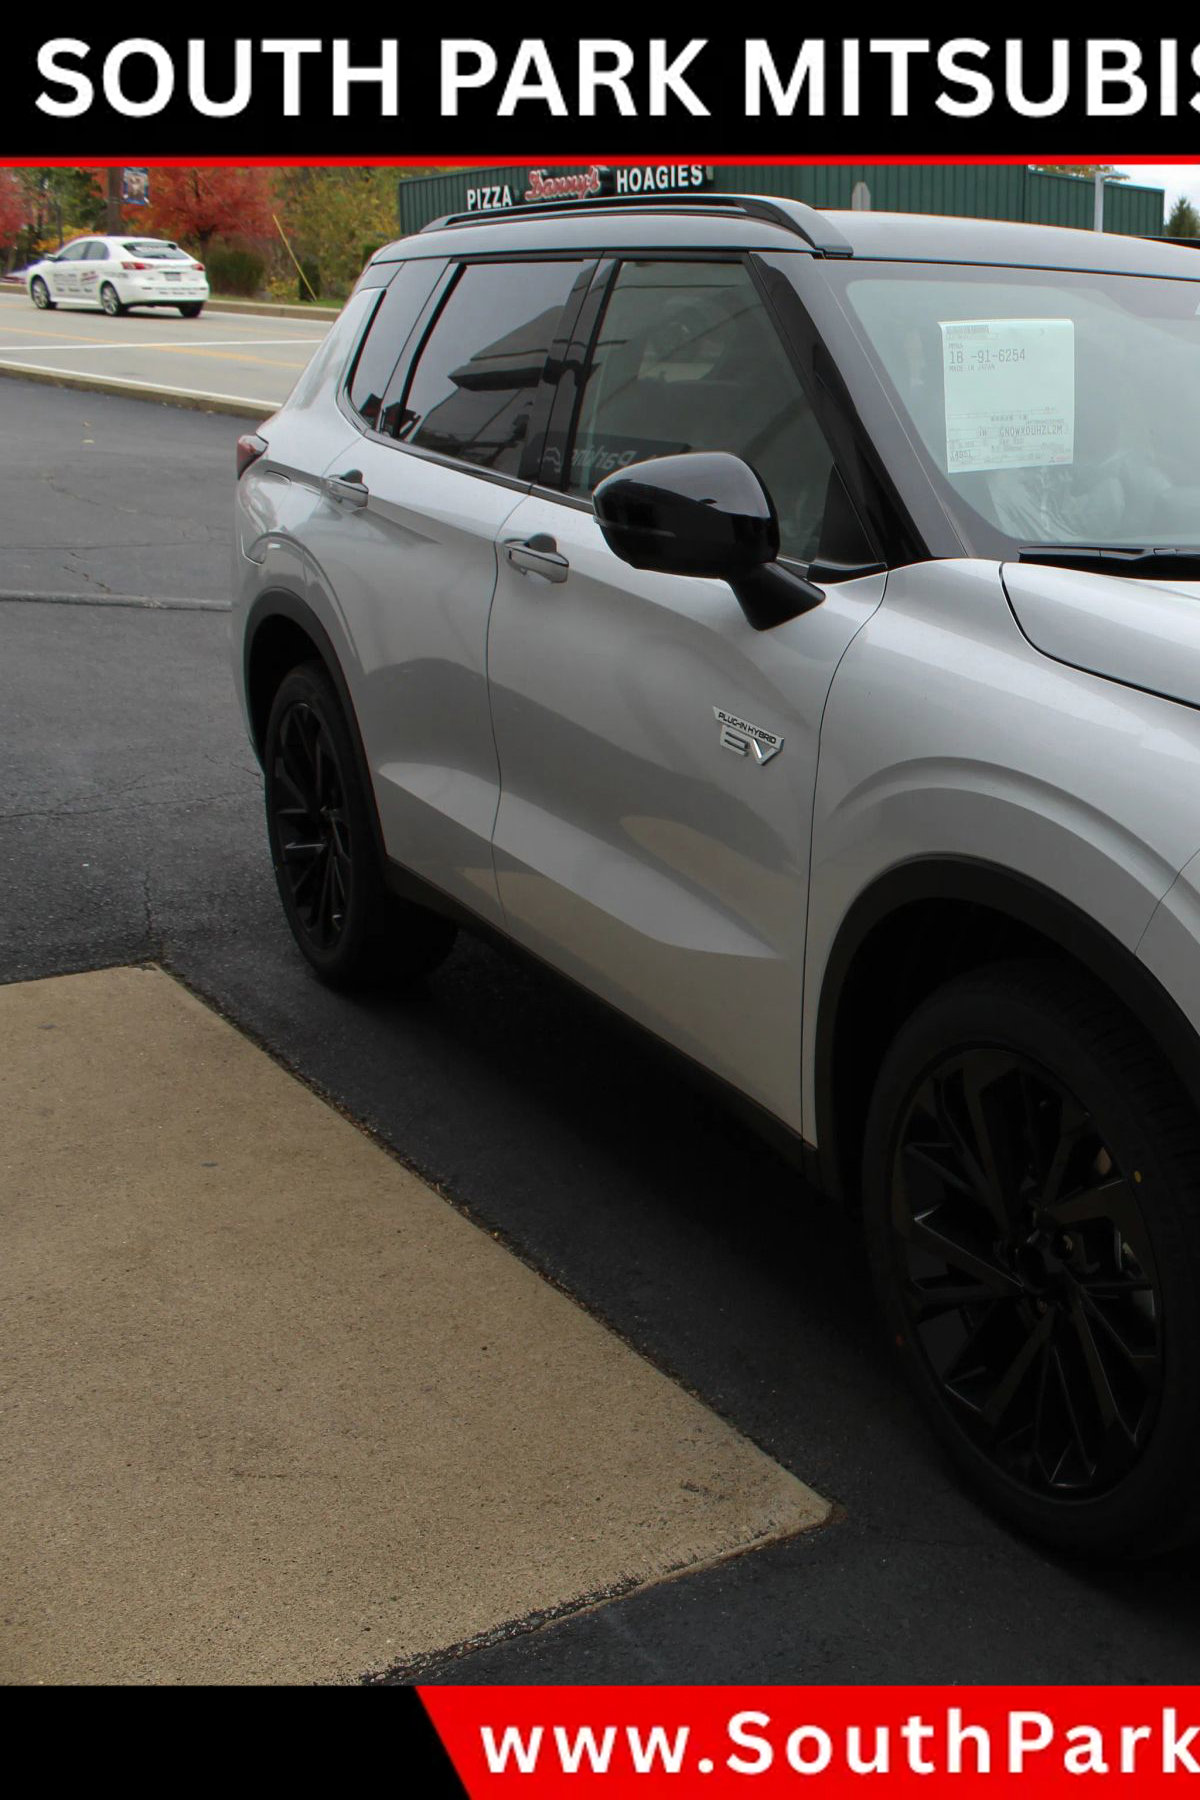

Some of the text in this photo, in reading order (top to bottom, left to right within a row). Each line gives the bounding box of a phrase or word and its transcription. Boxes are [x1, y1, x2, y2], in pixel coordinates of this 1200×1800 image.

[616, 165, 704, 193] HOAGIES
[467, 185, 513, 210] PIZZA
[718, 711, 777, 745] PLUG-IN HYBRID
